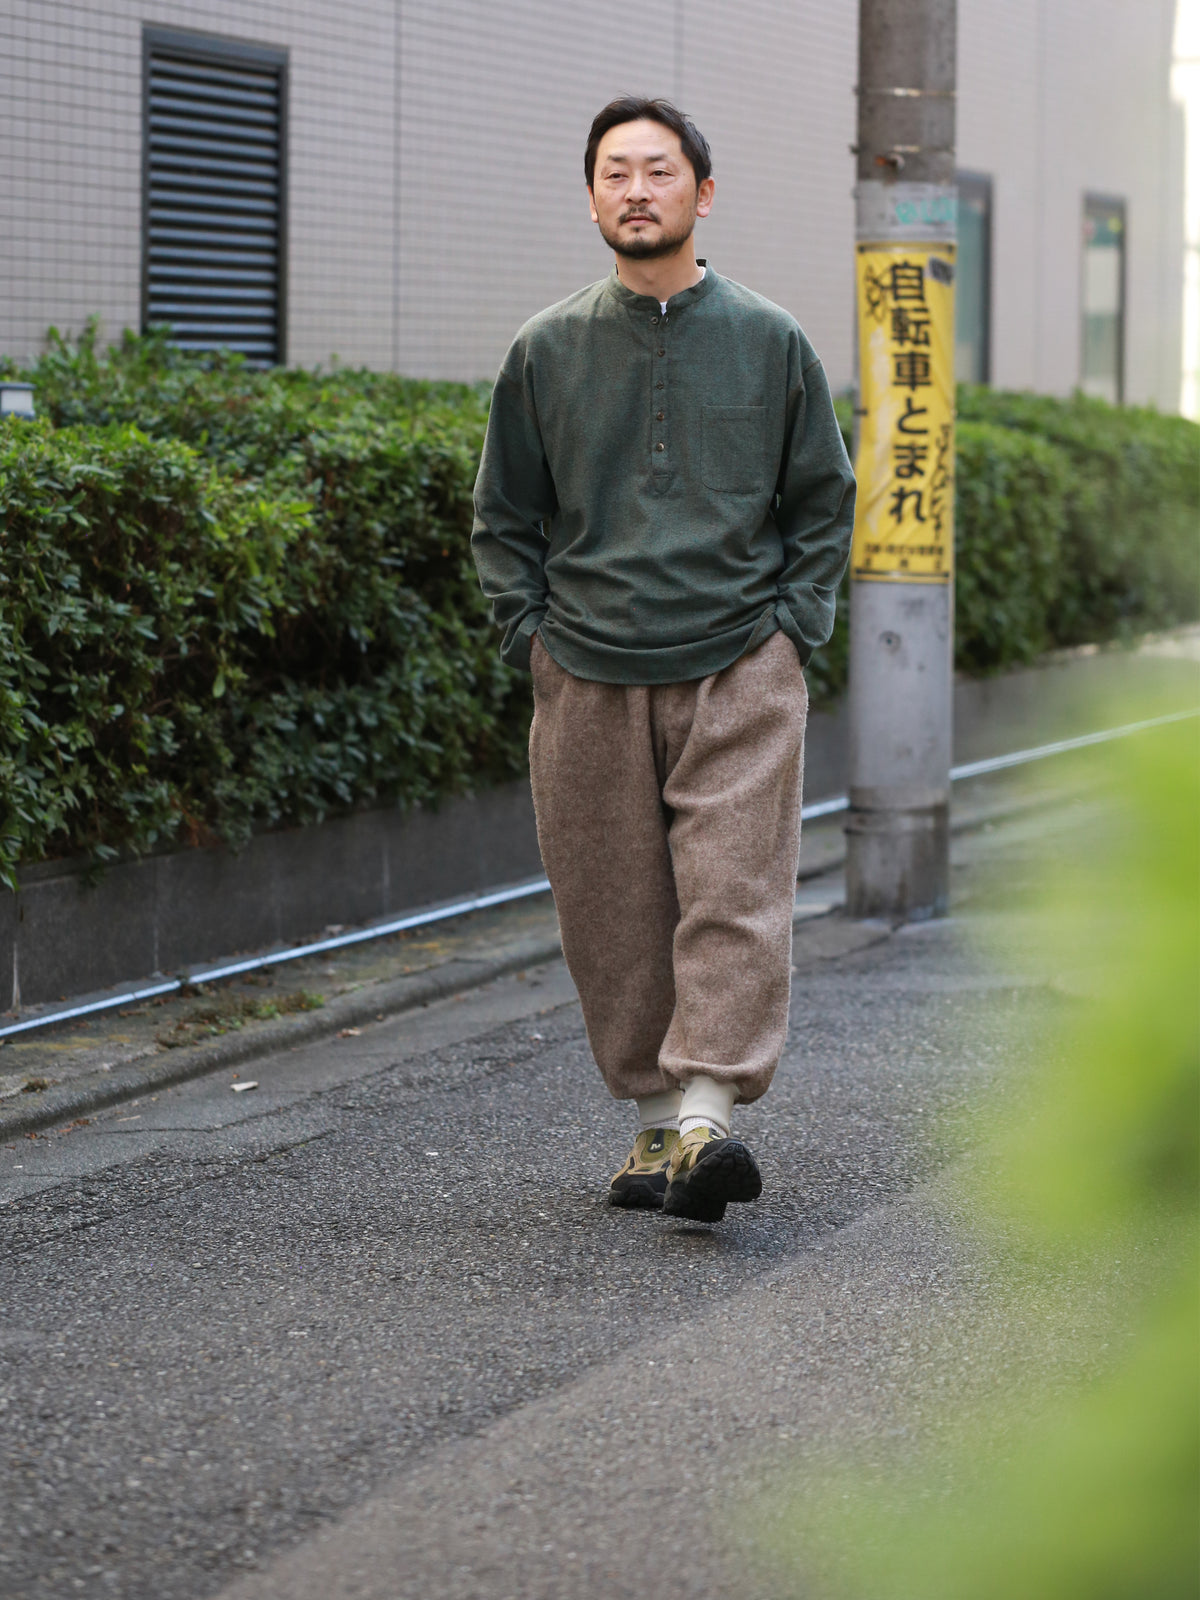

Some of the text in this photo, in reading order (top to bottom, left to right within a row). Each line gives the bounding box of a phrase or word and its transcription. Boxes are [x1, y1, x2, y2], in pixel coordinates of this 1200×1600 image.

[889, 261, 932, 524] 自転車とまれ
